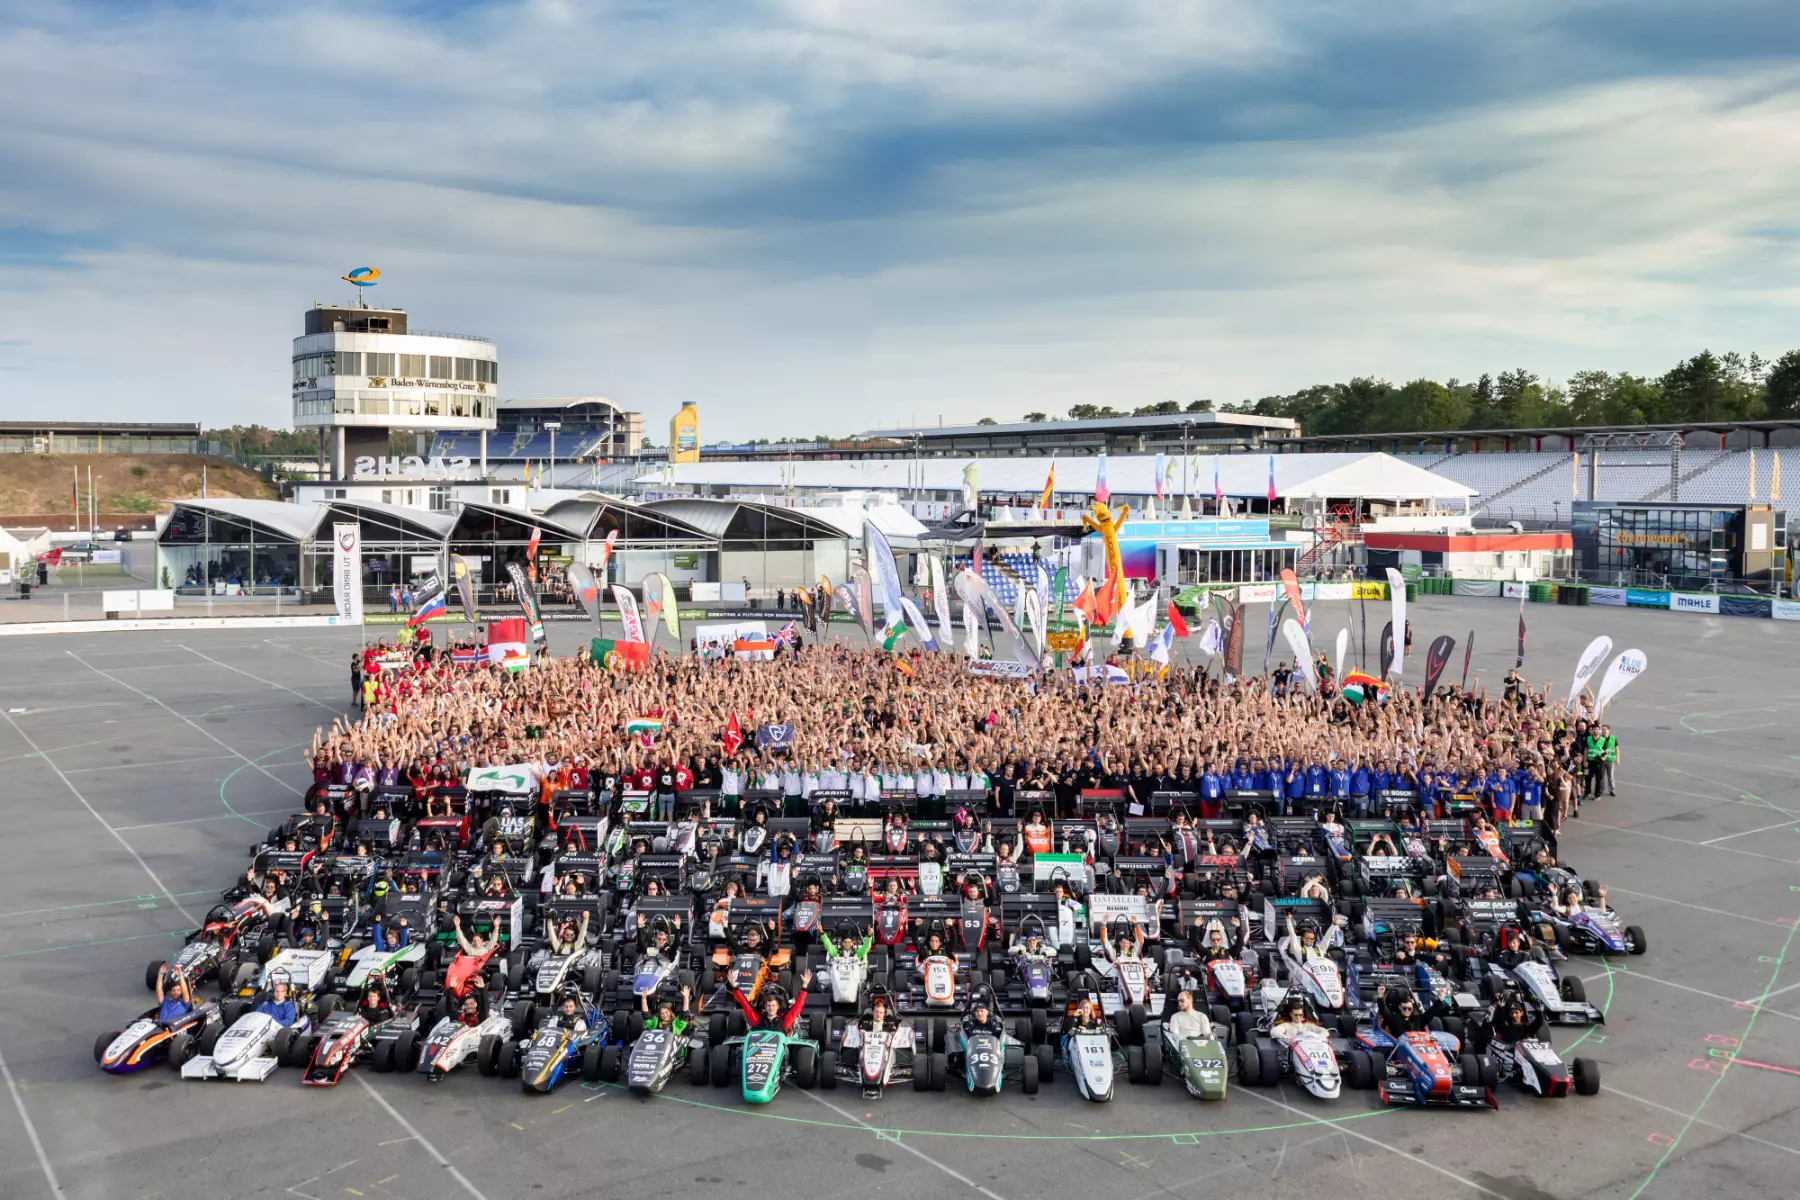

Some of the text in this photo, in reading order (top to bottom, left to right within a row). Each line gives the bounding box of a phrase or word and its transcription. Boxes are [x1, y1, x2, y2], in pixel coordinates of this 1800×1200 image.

[1677, 597, 1711, 608] MAHLE
[1201, 855, 1239, 865] FNSS
[1094, 896, 1141, 904] DAIMLER
[1274, 898, 1312, 906] SIEMENS
[964, 920, 981, 928] 53
[741, 961, 752, 969] 40
[427, 1035, 449, 1046] 442
[537, 1036, 557, 1047] 68
[643, 1033, 665, 1043] 36
[970, 1052, 999, 1065] 363
[1193, 1059, 1223, 1068] 372
[747, 1063, 769, 1073] 272
